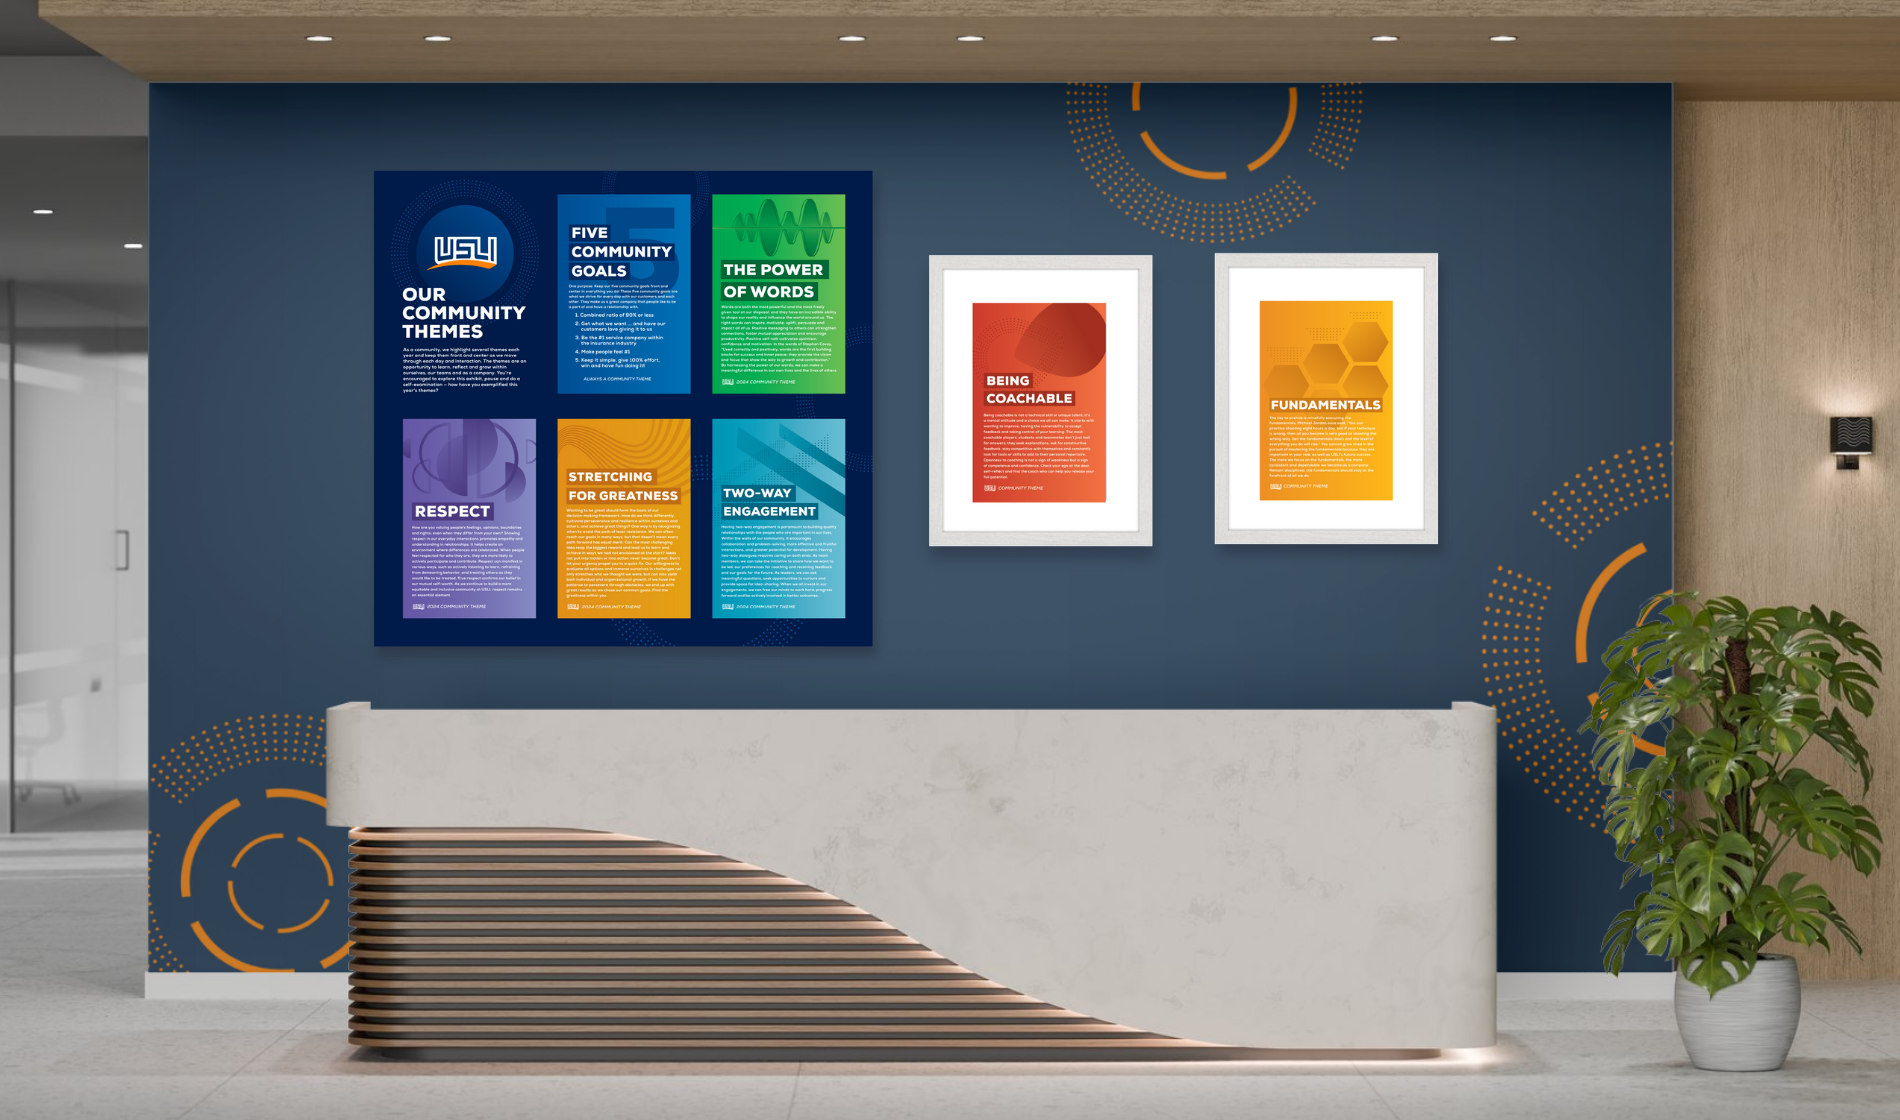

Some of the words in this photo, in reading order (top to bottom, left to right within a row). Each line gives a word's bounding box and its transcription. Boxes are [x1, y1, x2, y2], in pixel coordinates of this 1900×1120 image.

[572, 227, 607, 238] FIVE
[572, 246, 672, 257] COMMUNITY
[572, 265, 626, 277] GOALS
[724, 264, 756, 275] THE
[761, 264, 823, 275] POWER
[403, 288, 445, 301] OUR
[724, 286, 746, 298] OF
[750, 286, 814, 298] WORDS
[403, 306, 526, 320] COMMUNITY
[402, 324, 483, 338] THEMES
[987, 376, 1029, 386] BEING
[987, 394, 1072, 403] COACHABLE
[1272, 400, 1381, 410] FUNDAMENTALS
[569, 472, 652, 482] STRETCHING
[569, 491, 596, 500] FOR
[599, 491, 678, 500] GREATNESS
[723, 488, 791, 498] TWO-WAY
[416, 505, 490, 517] RESPECT
[724, 507, 816, 516] ENGAGEMENT
